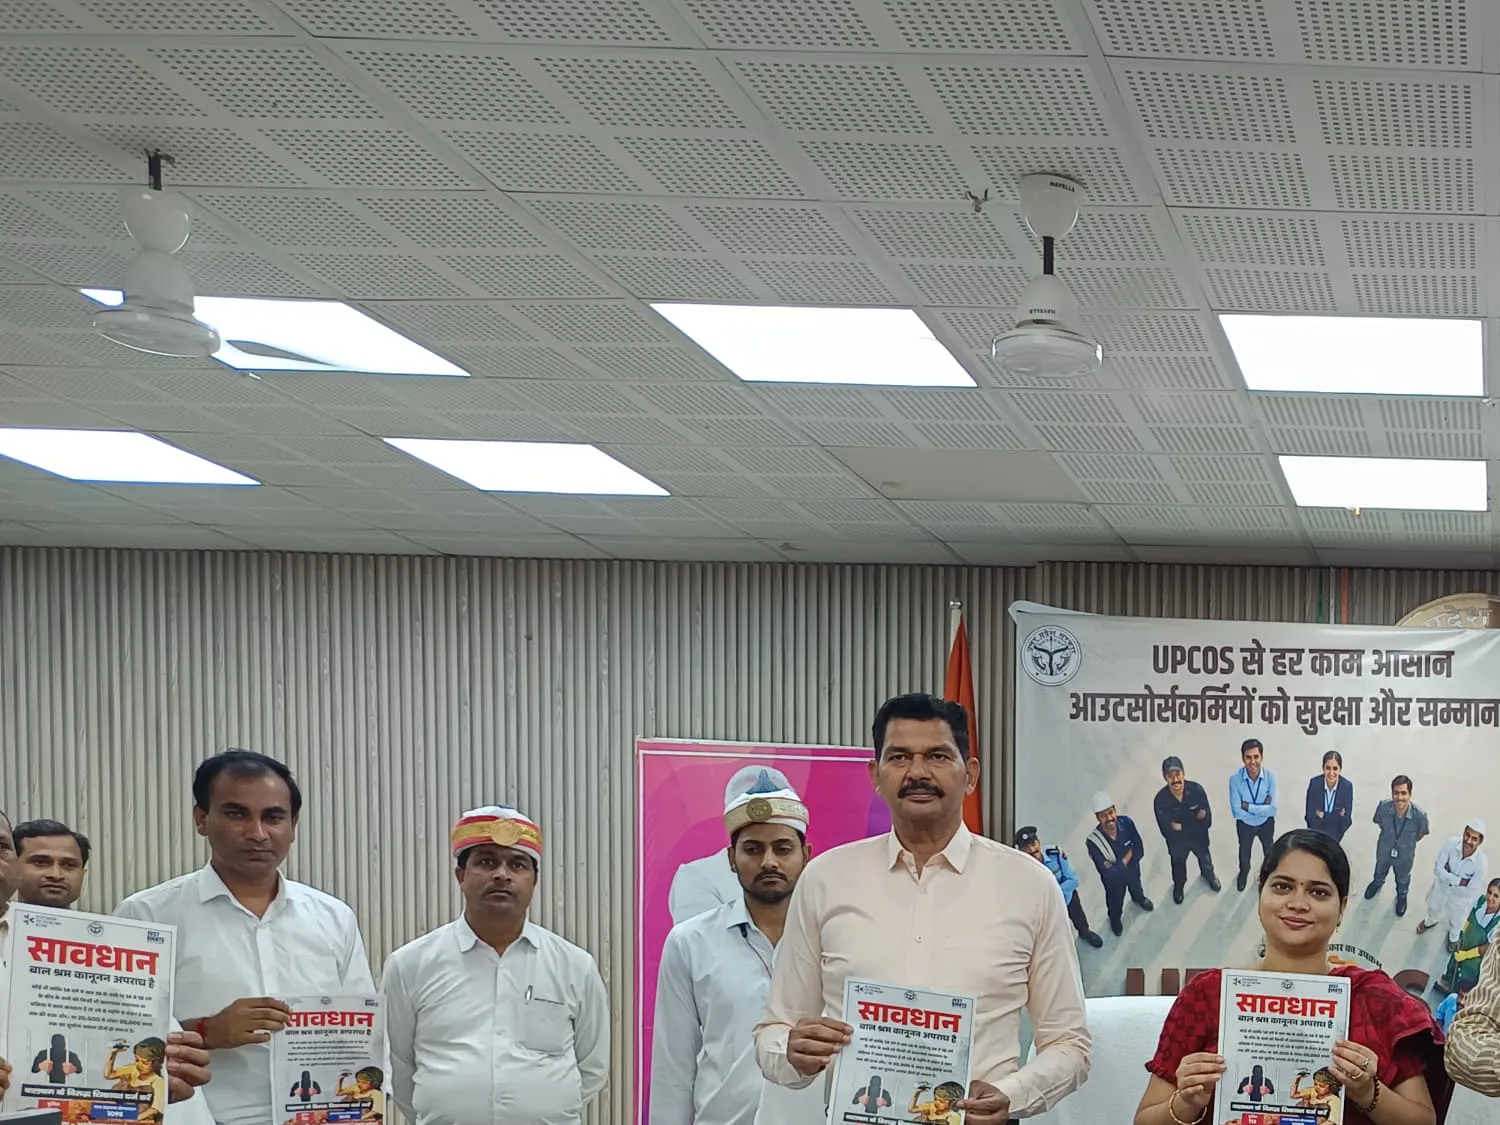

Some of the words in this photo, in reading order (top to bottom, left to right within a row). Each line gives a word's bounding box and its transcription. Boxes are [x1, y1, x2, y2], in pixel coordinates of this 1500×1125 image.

[1153, 645, 1235, 675] UPCOS
[1240, 638, 1266, 675] से
[1270, 648, 1305, 676] हर
[1309, 648, 1365, 677] काम
[1371, 649, 1455, 678] आसान
[1069, 683, 1258, 724] आउटसोर्सकर्मियों
[1259, 686, 1290, 725] को
[1294, 696, 1363, 735] सुरक्षा
[1369, 688, 1412, 727] और
[27, 935, 159, 975] सावधान
[286, 1011, 374, 1028] सावधान
[857, 1000, 962, 1033] सावधान
[1236, 993, 1337, 1018] सावधान
